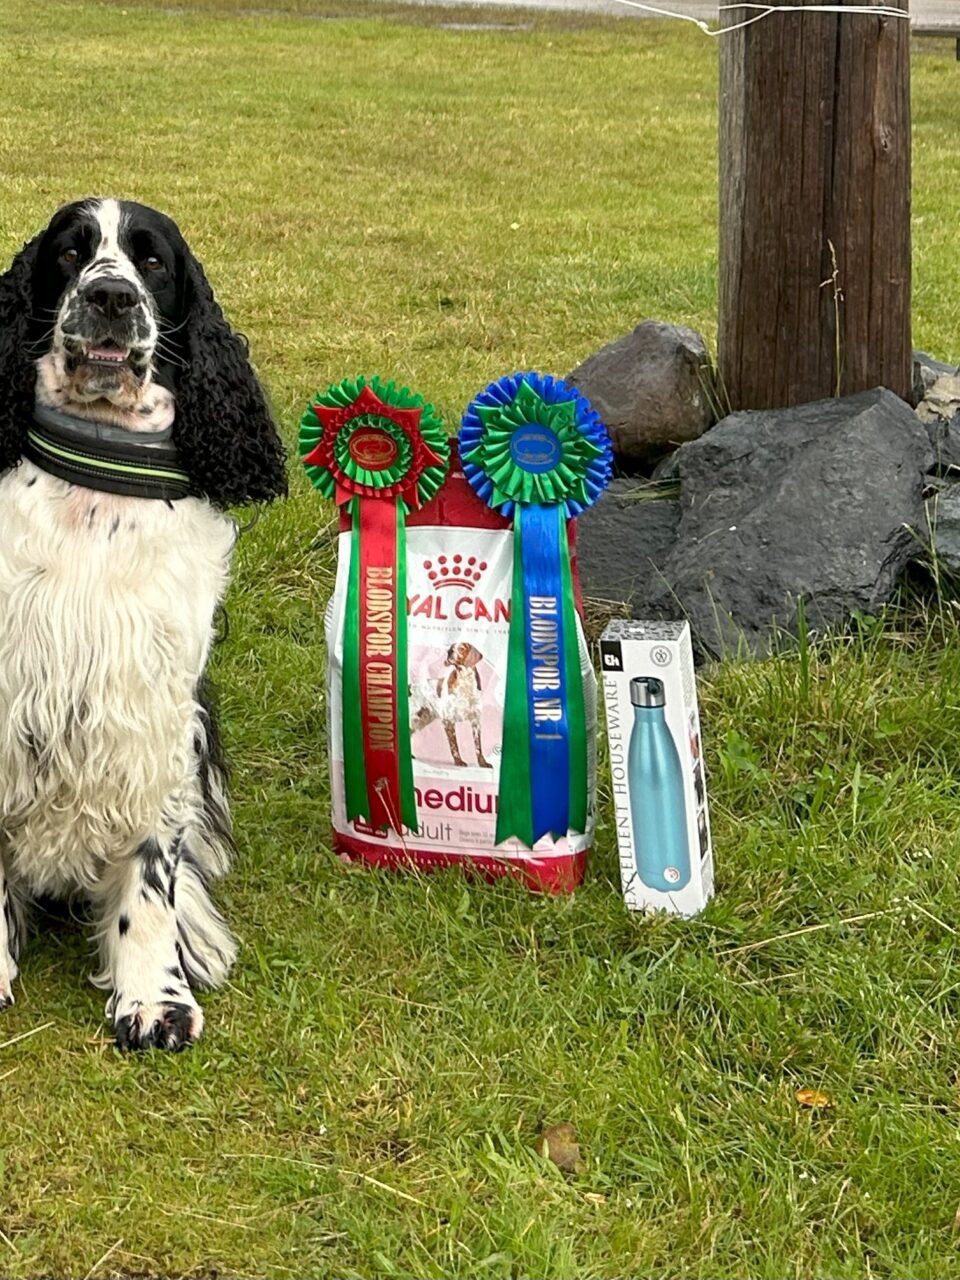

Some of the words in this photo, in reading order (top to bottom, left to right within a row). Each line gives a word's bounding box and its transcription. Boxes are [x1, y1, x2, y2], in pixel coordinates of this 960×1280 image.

[366, 566, 393, 658] BLODSPOR
[529, 596, 561, 692] BLODSPOR
[367, 661, 394, 752] CHAMPION
[414, 786, 498, 814] ediu
[616, 803, 638, 908] EXCELLENT
